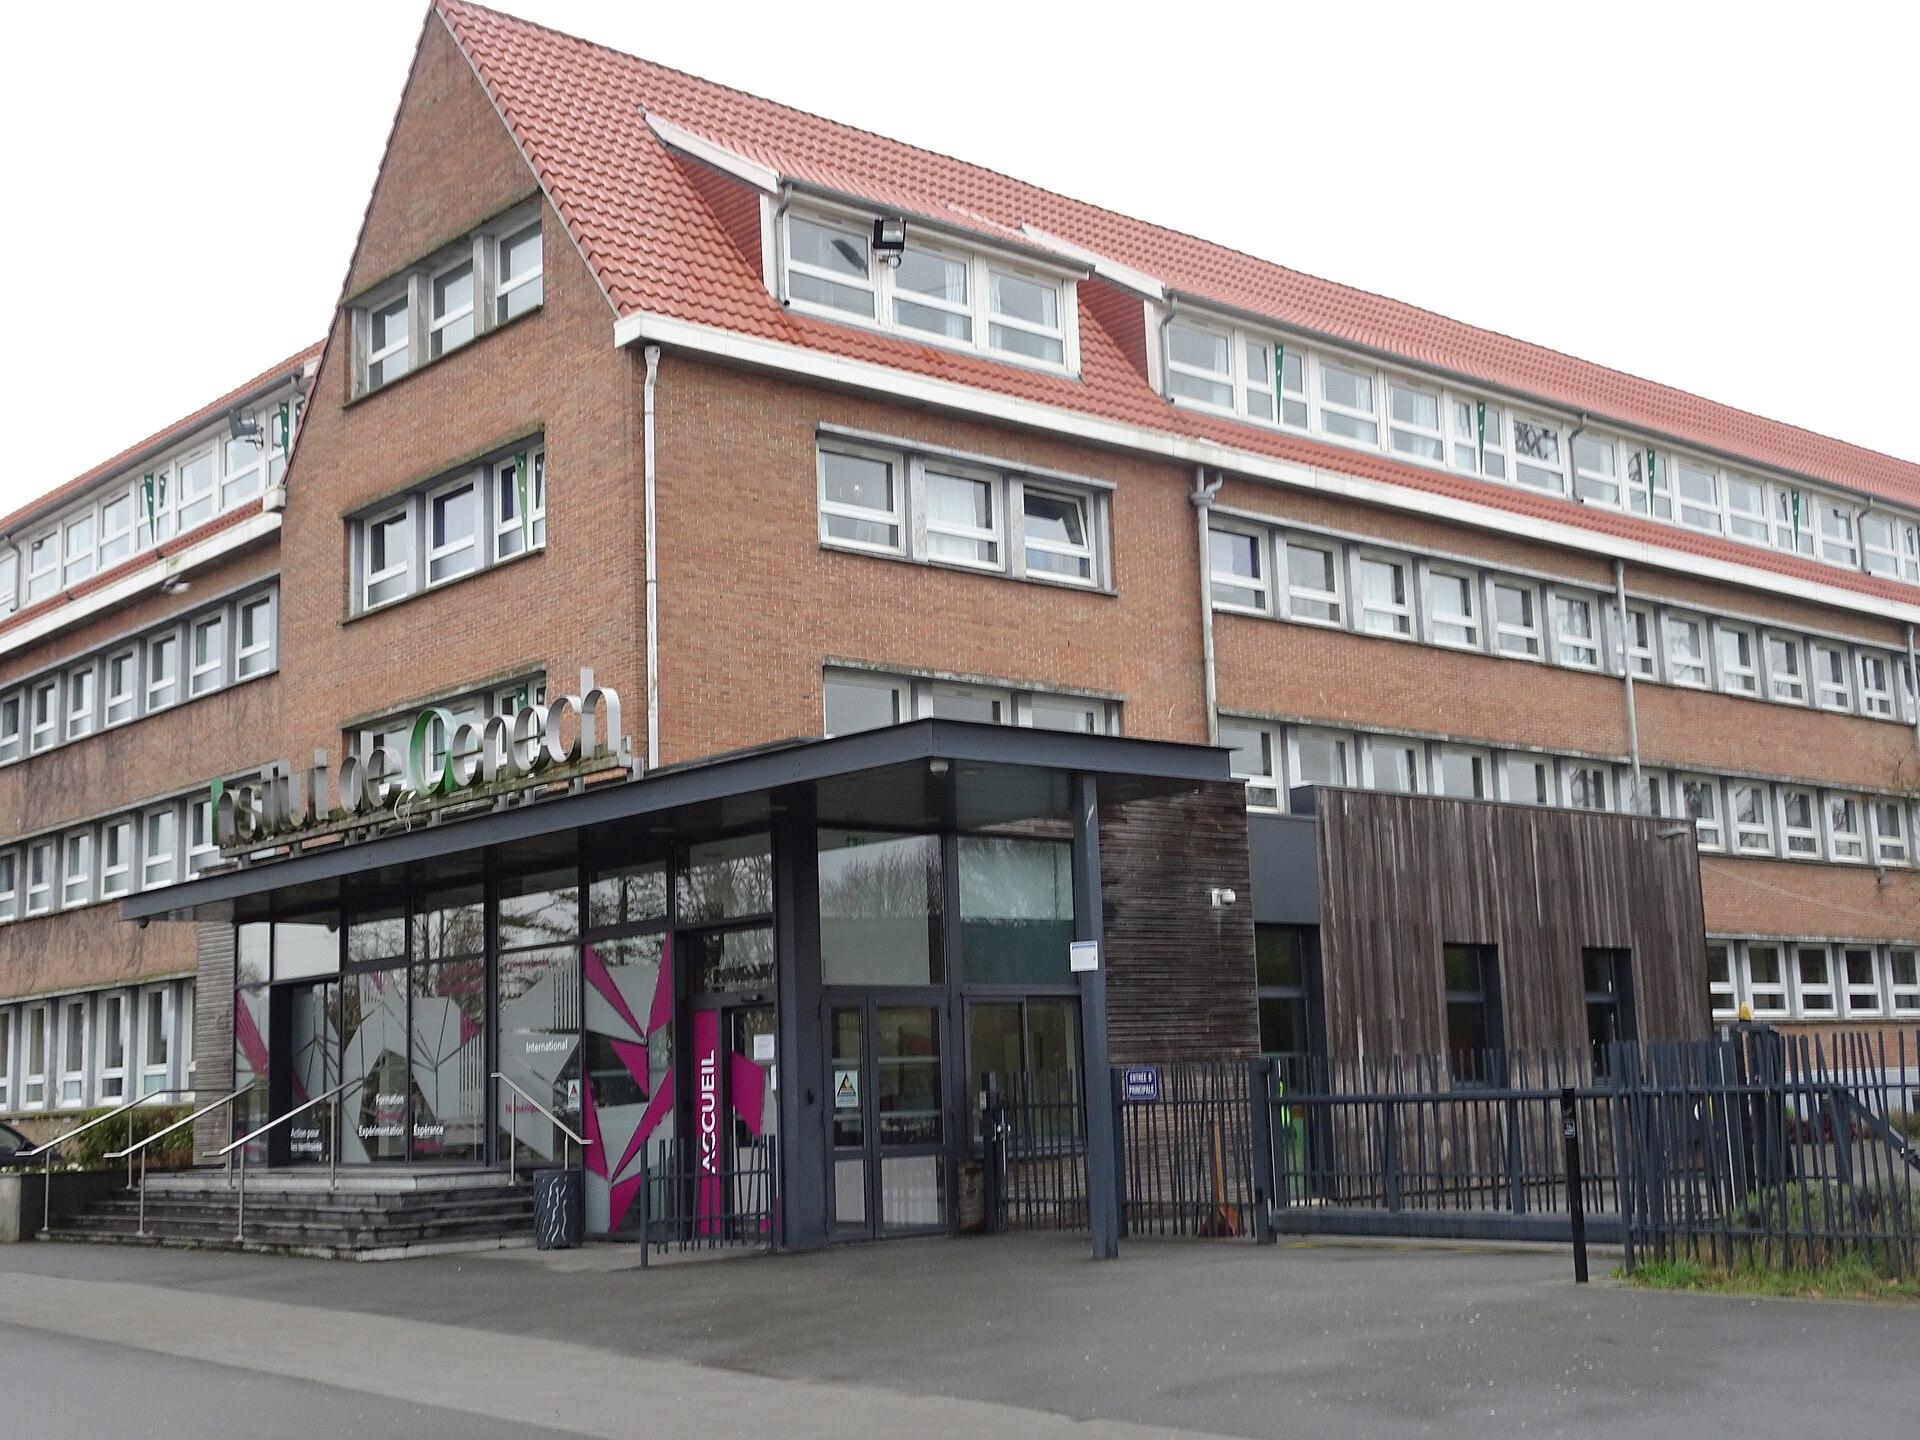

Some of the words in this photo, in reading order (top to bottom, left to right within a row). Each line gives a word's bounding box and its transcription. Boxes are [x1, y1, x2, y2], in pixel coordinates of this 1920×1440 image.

[339, 730, 400, 815] de
[408, 666, 621, 798] Genech
[525, 1038, 568, 1053] International
[375, 1093, 405, 1106] Formation
[701, 1050, 716, 1175] ACCUEIL
[358, 1124, 404, 1139] Expérimentation
